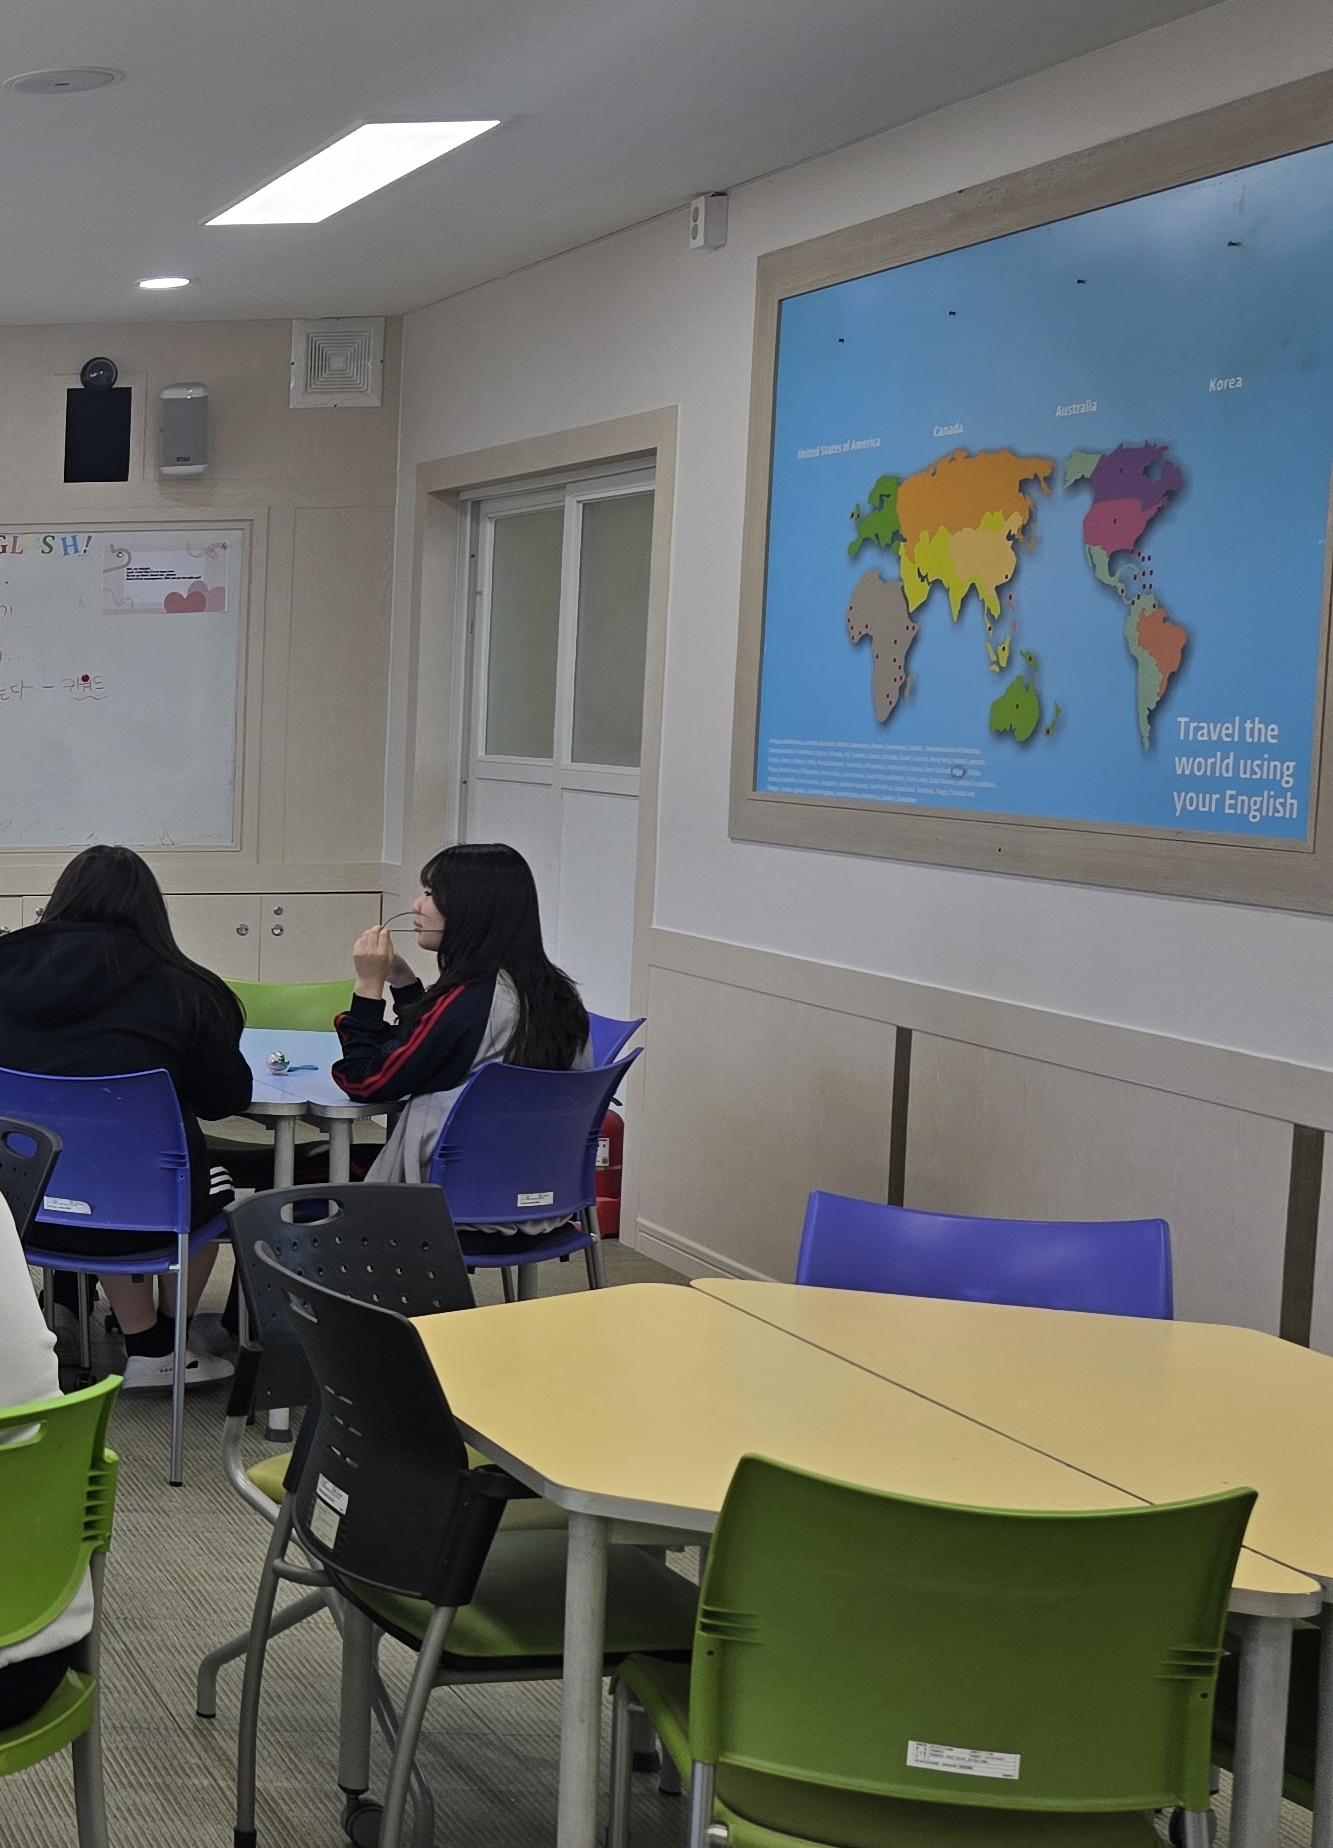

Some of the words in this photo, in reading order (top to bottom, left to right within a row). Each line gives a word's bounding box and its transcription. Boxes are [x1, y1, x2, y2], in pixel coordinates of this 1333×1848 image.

[1208, 376, 1243, 392] Korea
[1055, 399, 1097, 417] Australia
[933, 421, 964, 437] Canada
[797, 445, 820, 459] United
[820, 443, 842, 456] States
[842, 440, 850, 452] of
[851, 437, 881, 450] America
[1176, 716, 1240, 742] Travel
[1244, 716, 1279, 744] the
[1174, 751, 1234, 778] world
[1239, 753, 1296, 788] using
[1173, 791, 1220, 817] your
[1224, 790, 1298, 823] English
